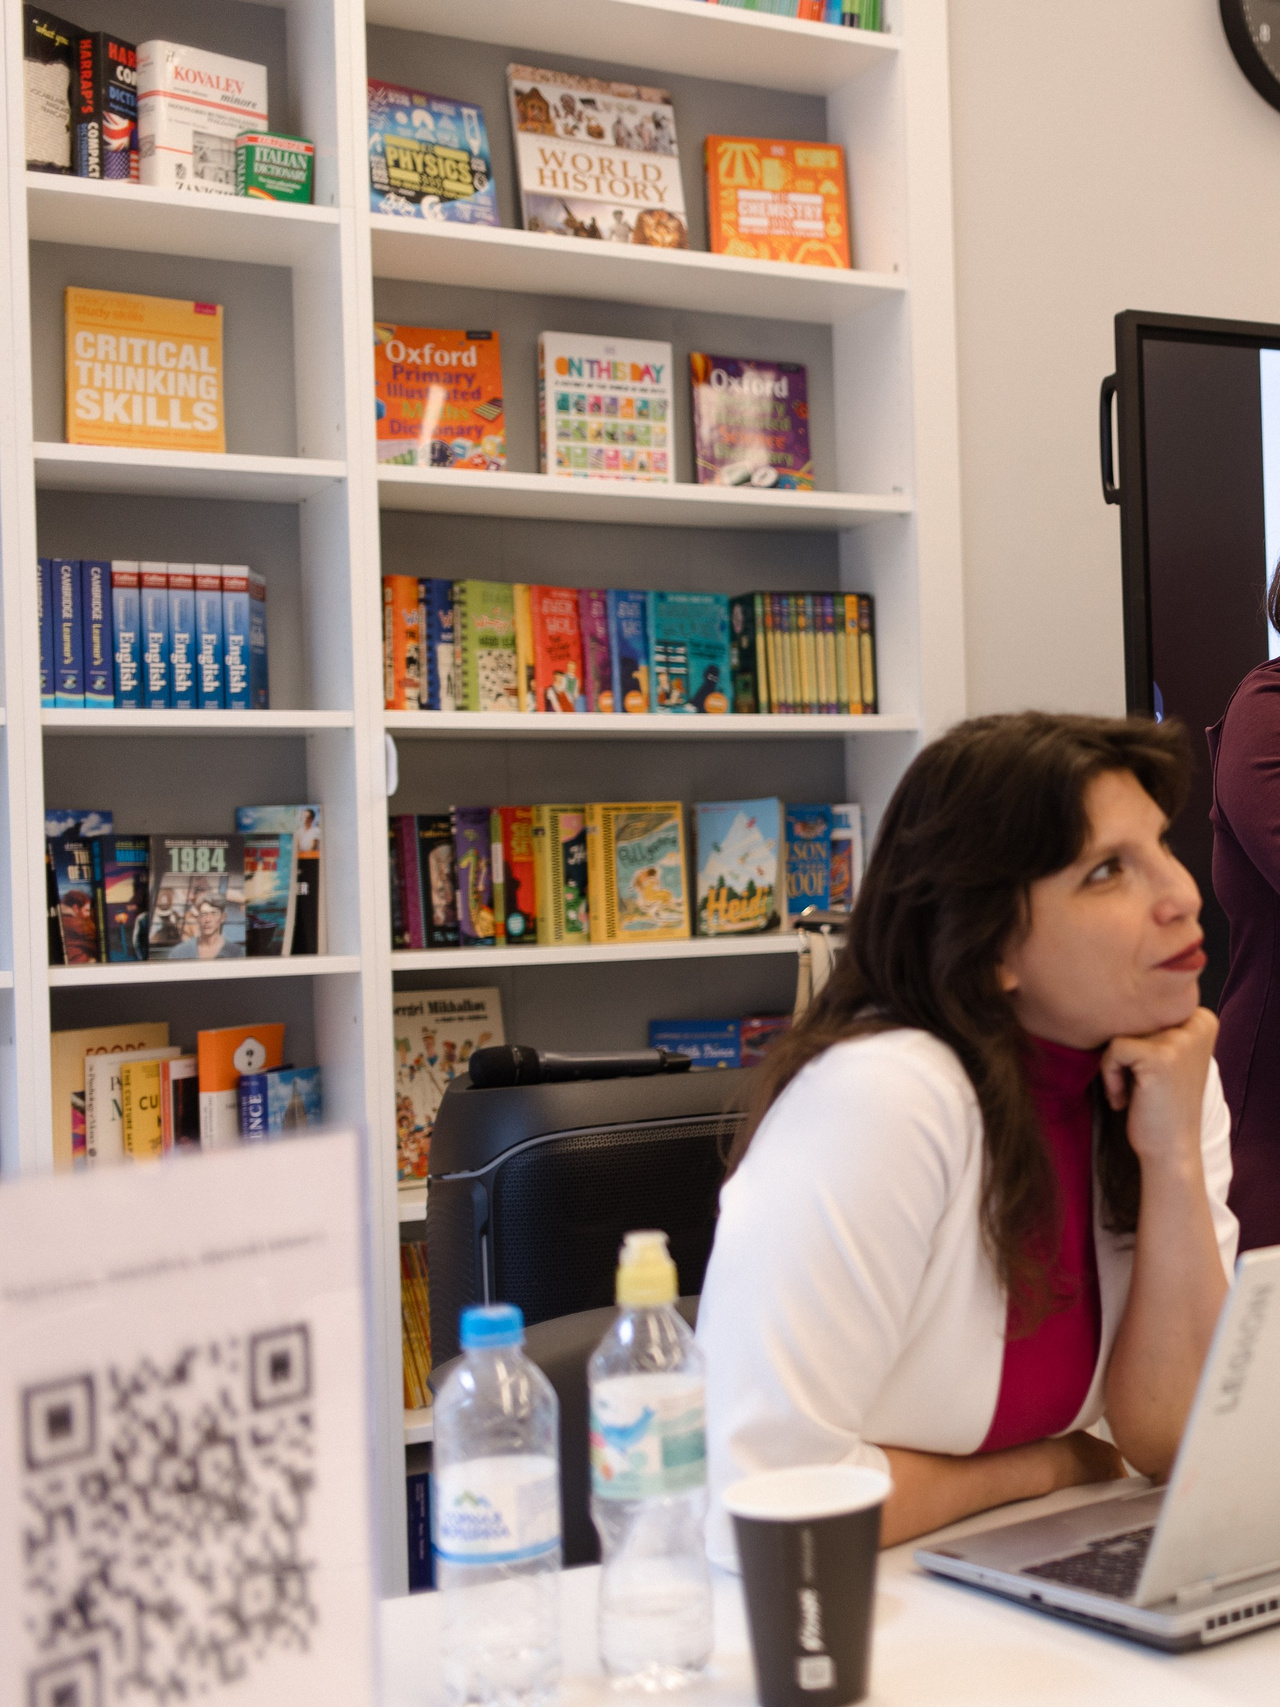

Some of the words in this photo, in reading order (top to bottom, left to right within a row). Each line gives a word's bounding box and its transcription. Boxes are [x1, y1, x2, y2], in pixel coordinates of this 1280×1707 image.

[1259, 23, 1271, 43] 8
[79, 38, 94, 114] HARRAP'S
[174, 65, 245, 94] KOVALEV
[87, 121, 100, 178] COMPACT
[255, 147, 308, 169] ITALIAN
[385, 145, 473, 184] PHYSICS
[538, 147, 664, 184] WORLD
[538, 167, 668, 205] HISTORY
[75, 330, 217, 374] CRITICAL
[385, 340, 478, 368] Oxford
[555, 356, 583, 378] ON
[585, 359, 628, 381] THIS
[630, 362, 664, 385] DAY
[75, 359, 218, 400] THINKING
[392, 364, 476, 388] Primary
[75, 388, 219, 432] SKILLS
[60, 565, 74, 620] CAMBRIDGE
[90, 566, 103, 621] CAMBRIDGE
[115, 631, 138, 692] English
[144, 632, 167, 692] English
[170, 632, 193, 692] English
[197, 633, 221, 693] English
[224, 635, 248, 693] English
[169, 847, 226, 873] 1984
[706, 885, 769, 925] Heidi
